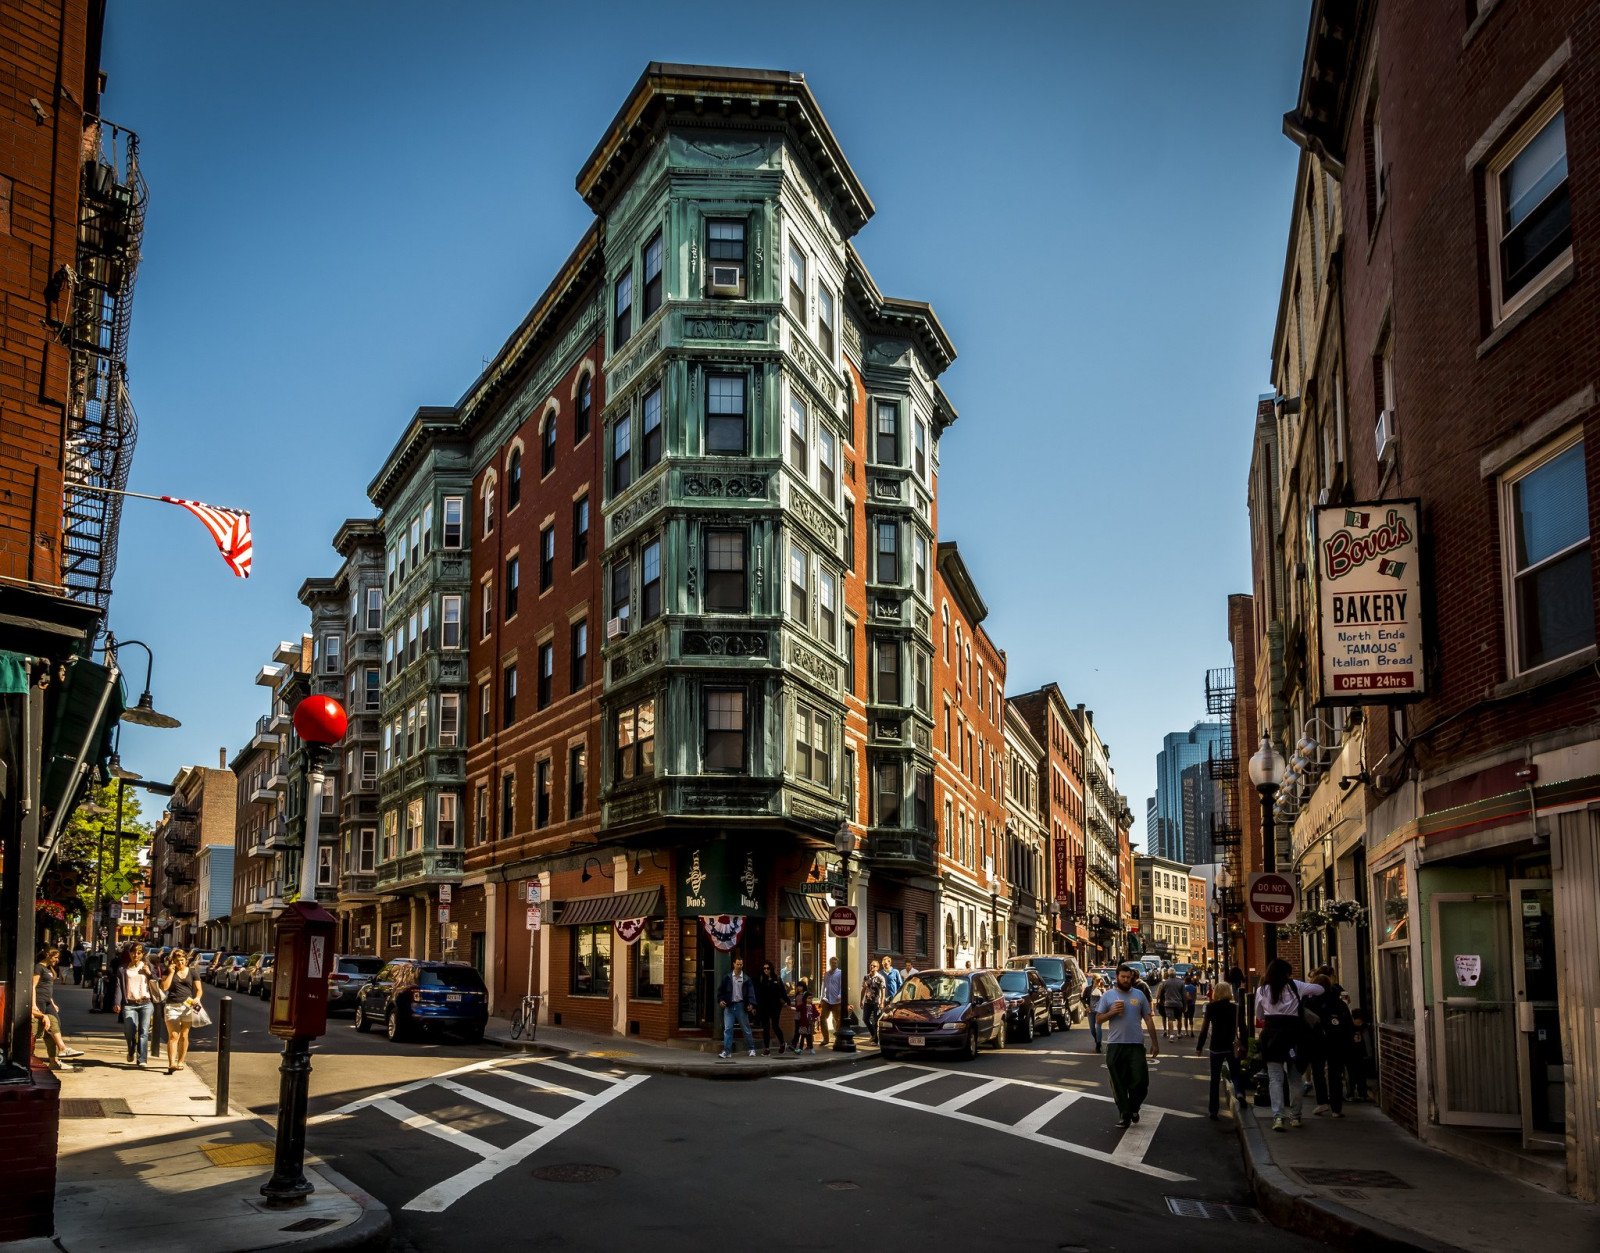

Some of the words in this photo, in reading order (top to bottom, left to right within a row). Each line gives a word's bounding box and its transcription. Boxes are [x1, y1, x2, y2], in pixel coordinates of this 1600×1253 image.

[1324, 510, 1412, 579] Bova's
[1333, 593, 1407, 623] BAKERY
[1338, 631, 1371, 642] North
[1378, 628, 1405, 640] End's
[1332, 657, 1370, 667] Italian
[1377, 654, 1413, 666] Bread
[1342, 676, 1371, 688] OPEN
[1376, 675, 1407, 687] 24hrs
[802, 883, 829, 893] PRINCE
[1258, 883, 1269, 891] DO
[1272, 884, 1287, 892] NOT
[686, 895, 706, 908] Dino's
[741, 894, 759, 910] Dino's
[1260, 904, 1285, 913] ENTER
